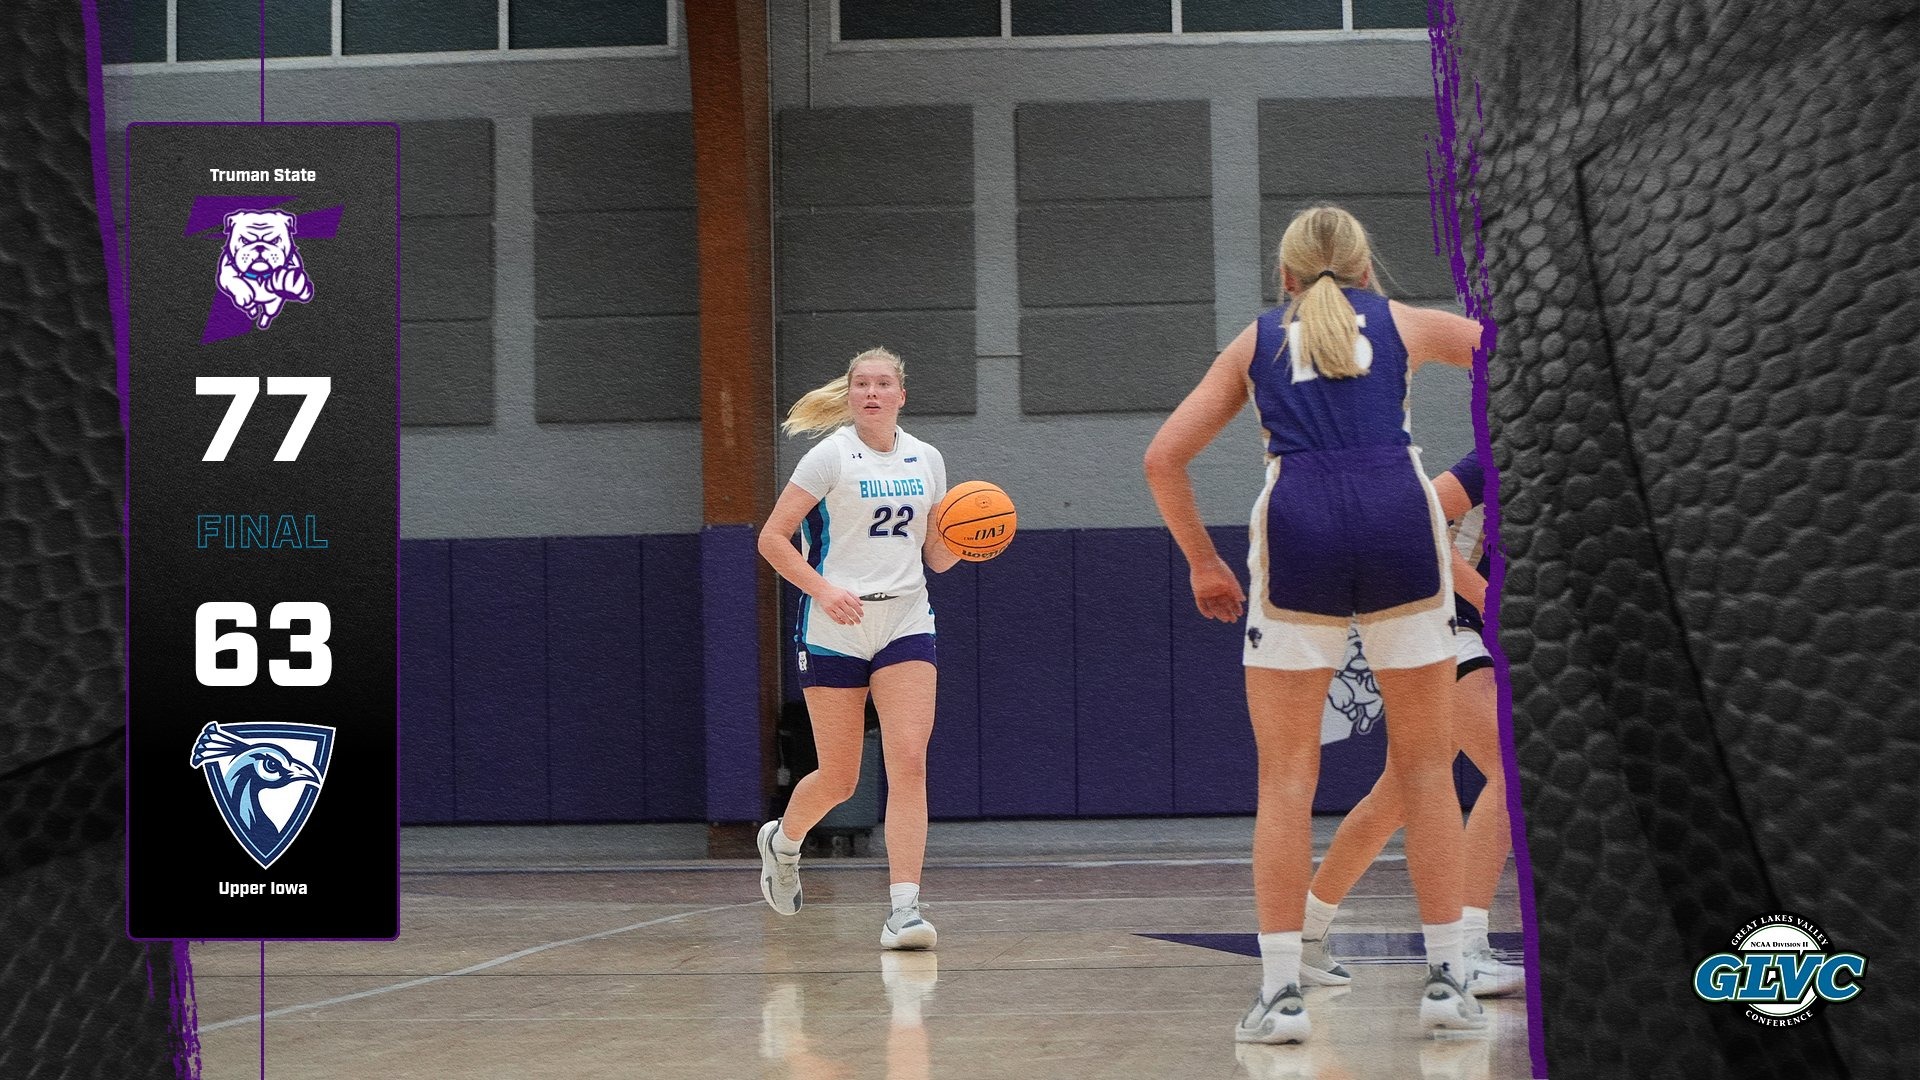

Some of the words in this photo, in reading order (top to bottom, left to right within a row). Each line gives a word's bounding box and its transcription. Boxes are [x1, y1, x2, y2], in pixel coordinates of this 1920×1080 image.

[859, 478, 925, 499] BULLDOGS
[868, 504, 915, 538] 22
[973, 524, 1005, 541] EVO
